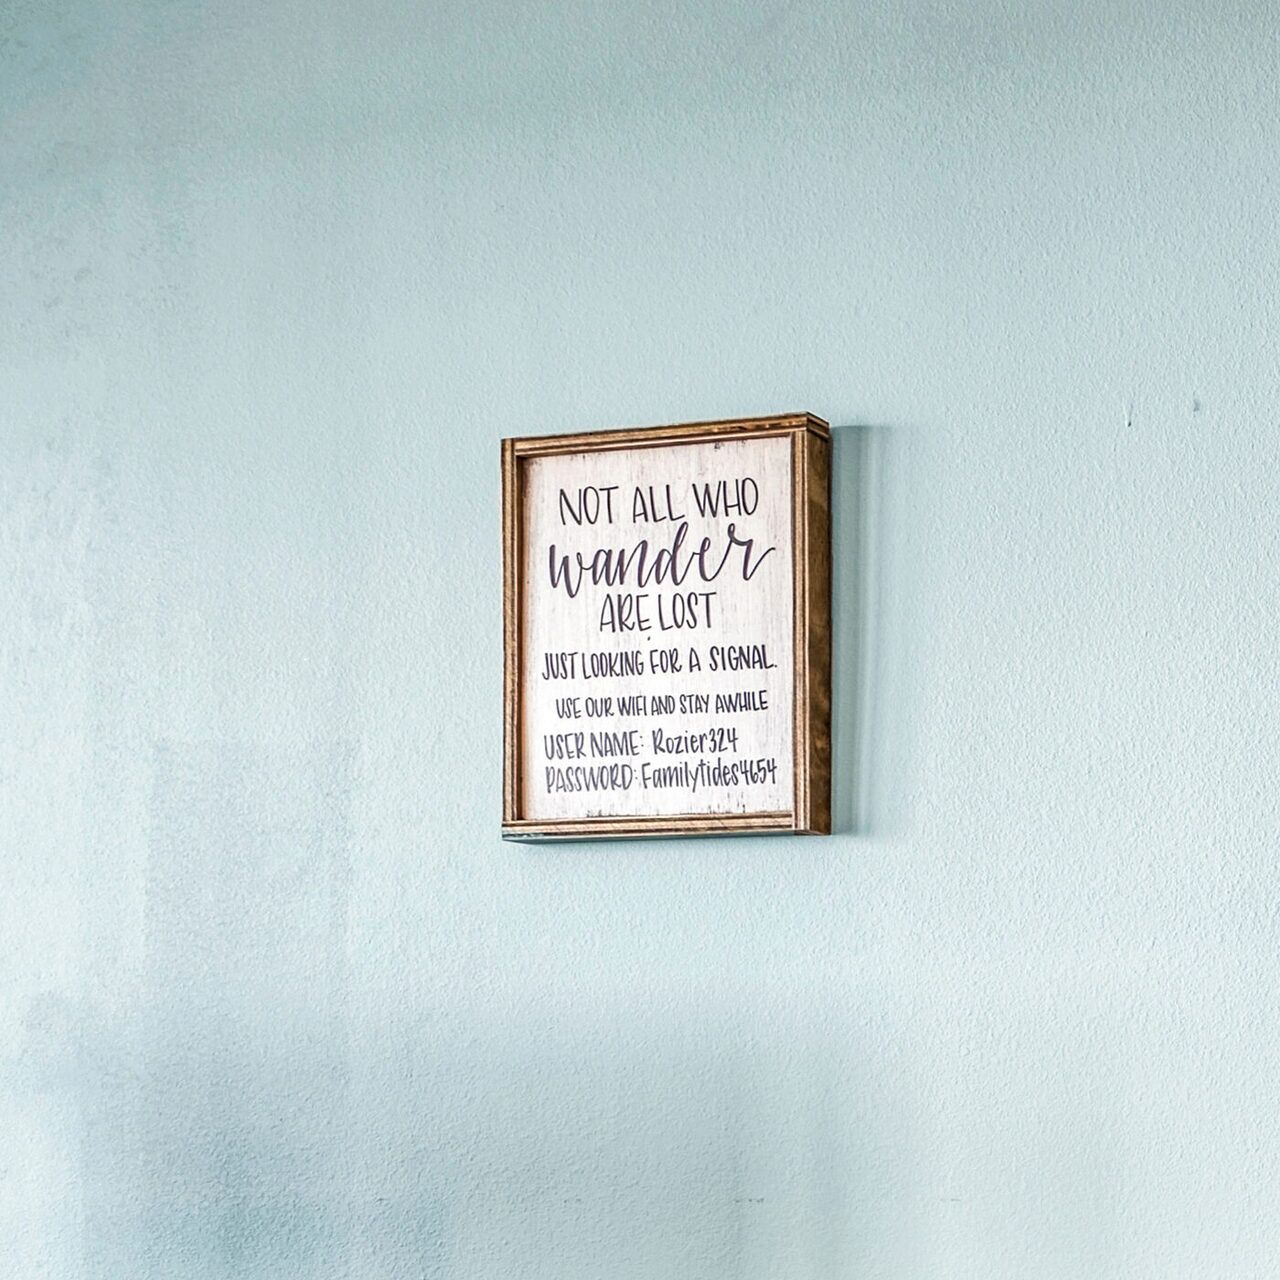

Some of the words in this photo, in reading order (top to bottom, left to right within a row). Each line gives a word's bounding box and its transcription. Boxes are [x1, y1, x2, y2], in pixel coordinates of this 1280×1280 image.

[559, 485, 619, 525] NOT
[632, 484, 685, 523] ALL
[692, 477, 759, 518] WHO
[549, 521, 776, 599] wander
[600, 593, 652, 633] ARE
[658, 591, 717, 631] LOST
[542, 651, 578, 681] JUST
[582, 650, 644, 680] LOOKING
[650, 647, 682, 674] FOR
[689, 647, 702, 673] A
[709, 644, 778, 672] SIGNAL.
[555, 697, 581, 719] USE
[585, 696, 615, 718] OUR
[617, 695, 648, 716] WIFI
[651, 695, 676, 716] AND
[679, 694, 710, 714] STAY
[715, 689, 769, 714] AWHILE
[544, 731, 586, 760] USER
[590, 730, 644, 757] NAME:
[652, 727, 739, 755] Rozier324
